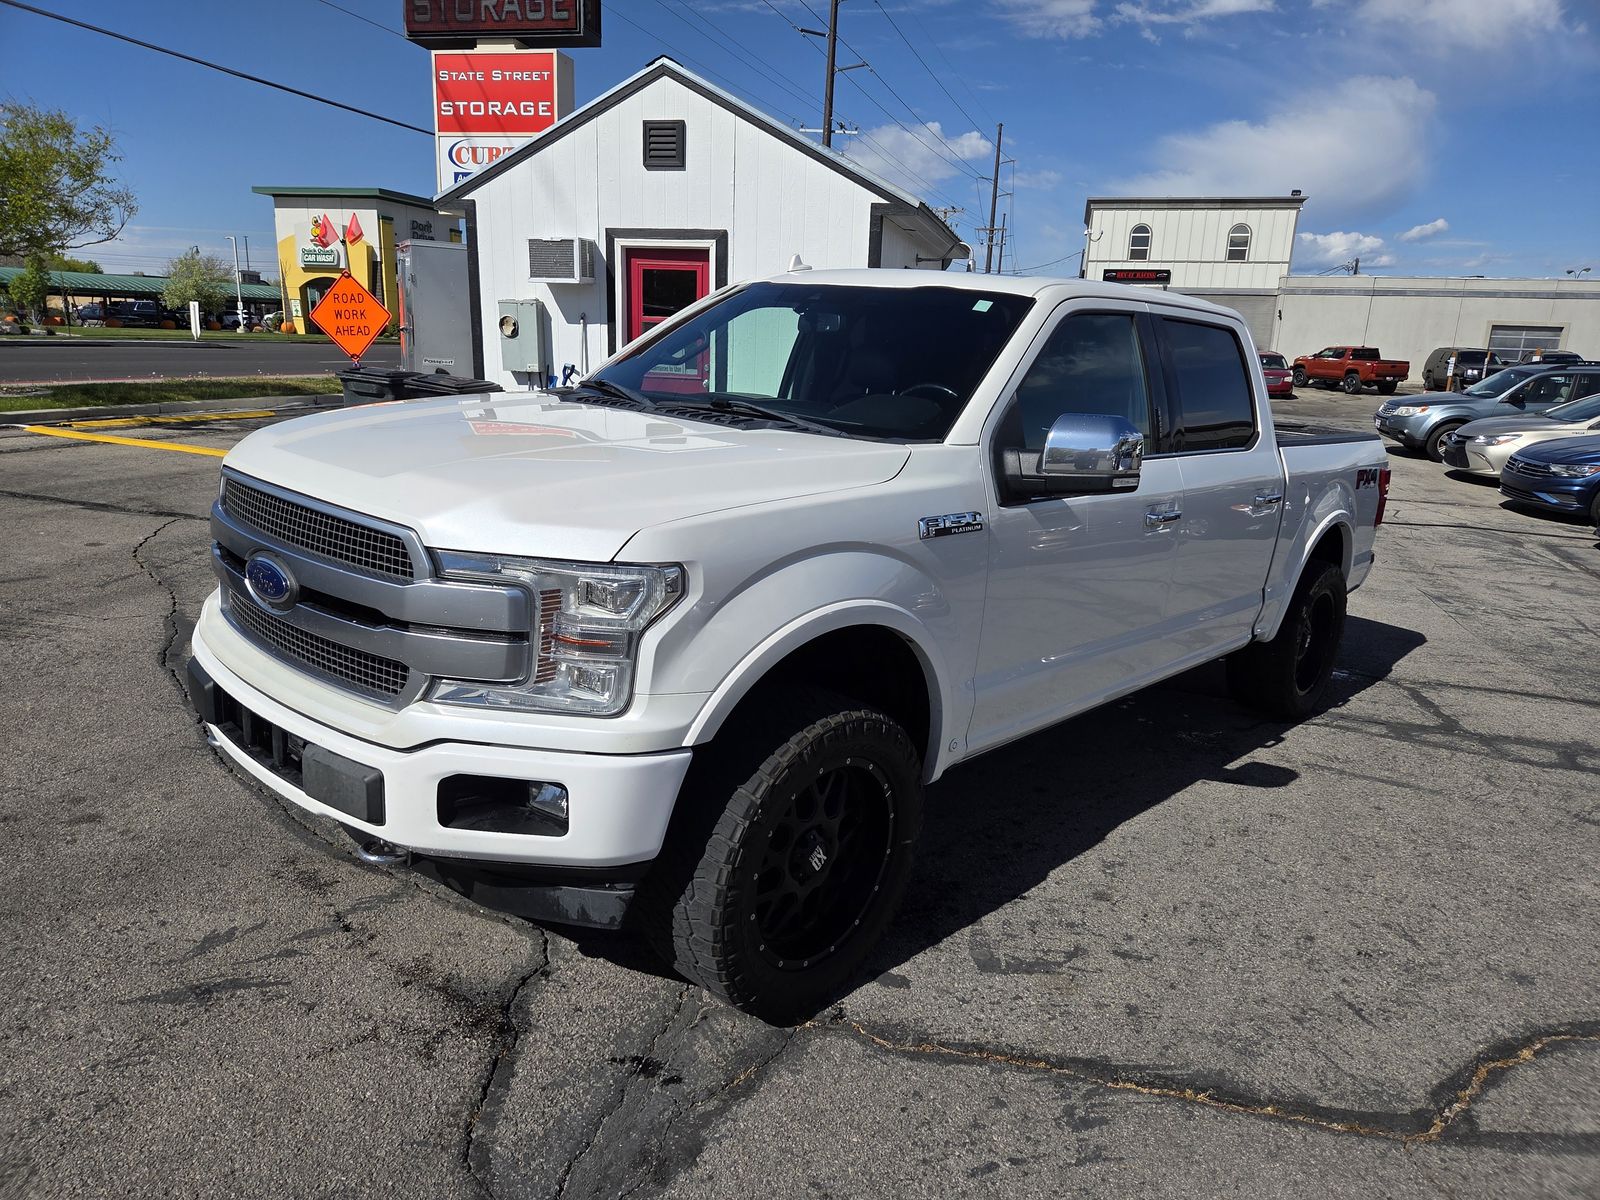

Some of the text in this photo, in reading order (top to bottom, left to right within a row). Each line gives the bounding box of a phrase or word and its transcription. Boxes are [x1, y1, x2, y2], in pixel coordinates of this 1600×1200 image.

[439, 70, 551, 81] STATE STREET
[440, 101, 552, 116] STORAGE
[303, 254, 334, 262] CAR WASH
[333, 292, 365, 304] ROAD
[334, 309, 367, 320] WORK
[335, 325, 371, 336] AHEAD
[1355, 468, 1378, 489] FX4
[951, 524, 981, 534] PLATINUM
